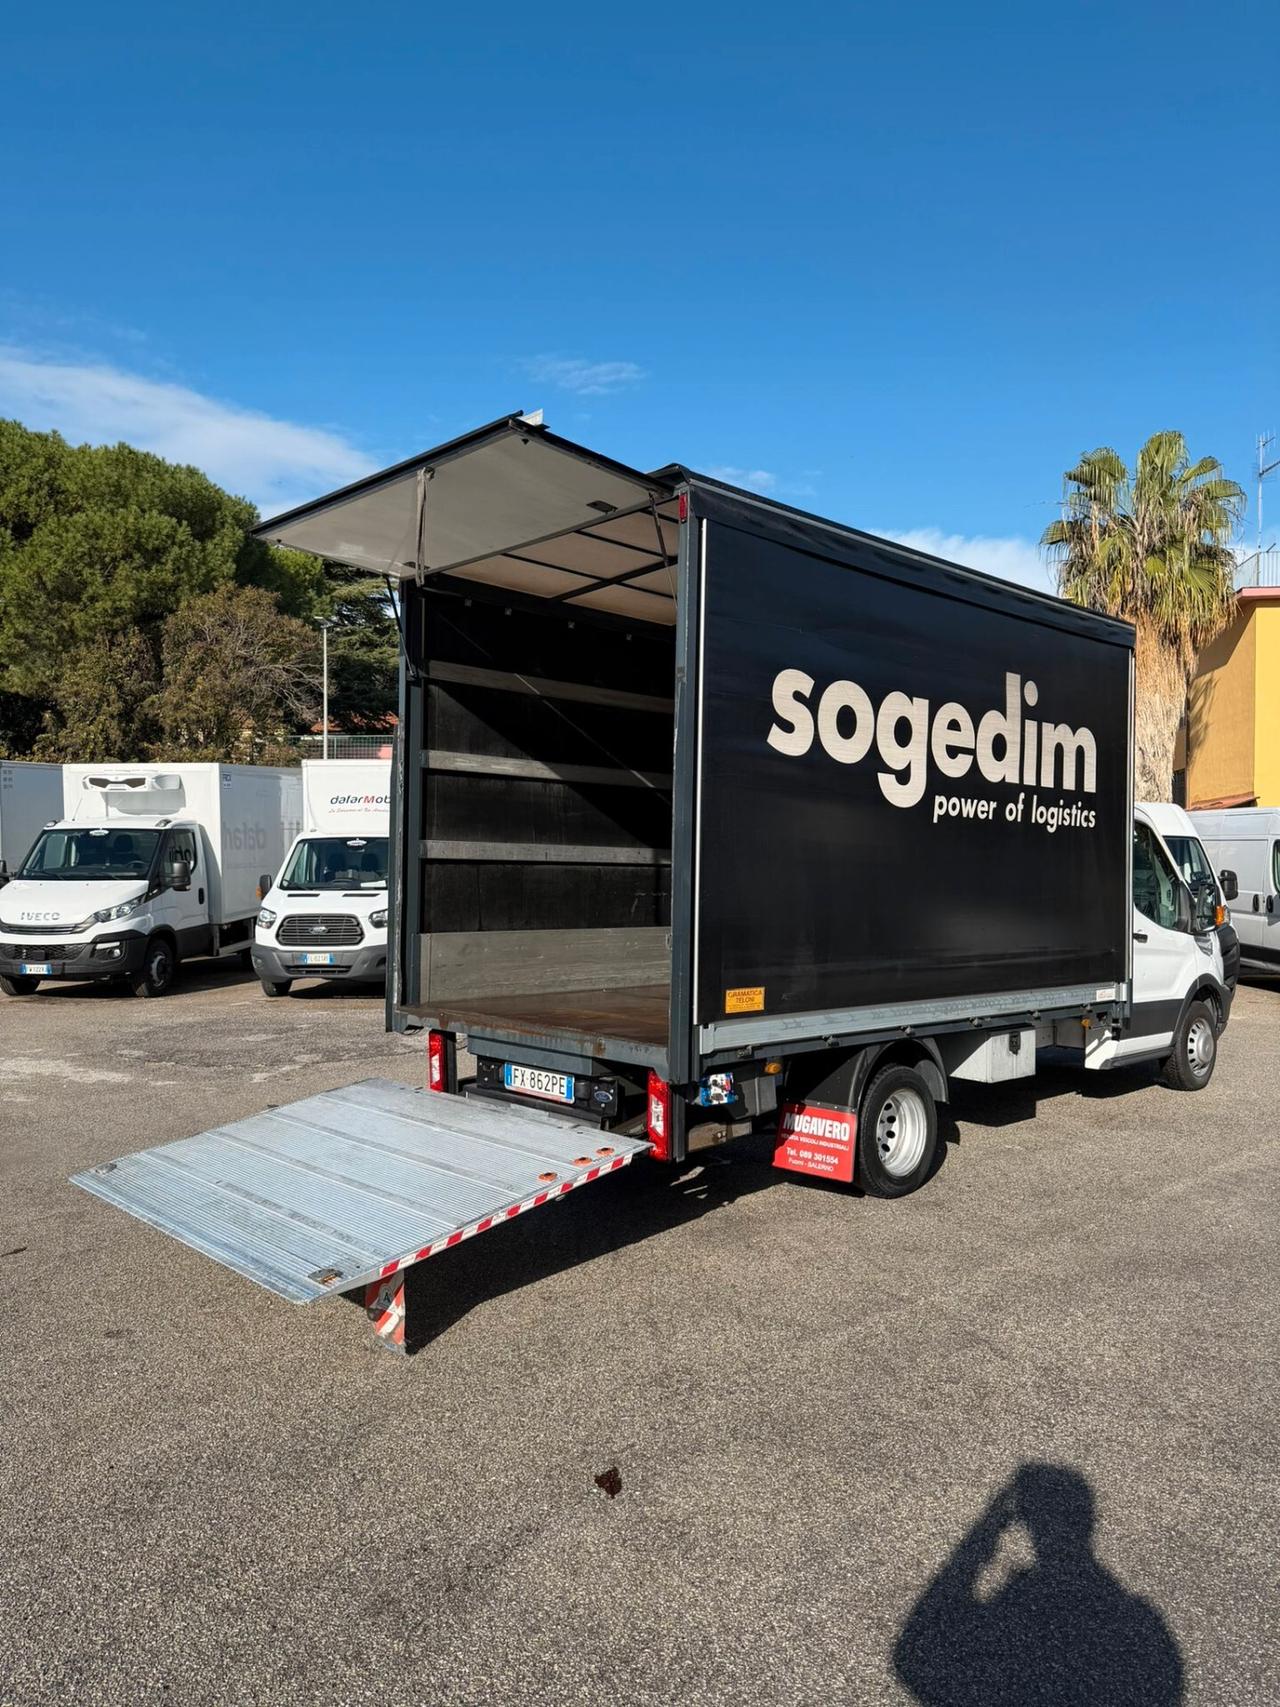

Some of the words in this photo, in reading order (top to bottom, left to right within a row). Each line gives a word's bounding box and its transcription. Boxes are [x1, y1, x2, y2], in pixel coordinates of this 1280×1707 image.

[766, 668, 1097, 808] sogedim
[933, 795, 997, 823] power
[1005, 793, 1024, 822] of
[1031, 795, 1096, 833] logistics
[20, 911, 60, 921] IVECO
[529, 1071, 566, 1095] 862PE
[783, 1113, 850, 1141] MUGAVERO
[786, 1147, 798, 1157] Tel.
